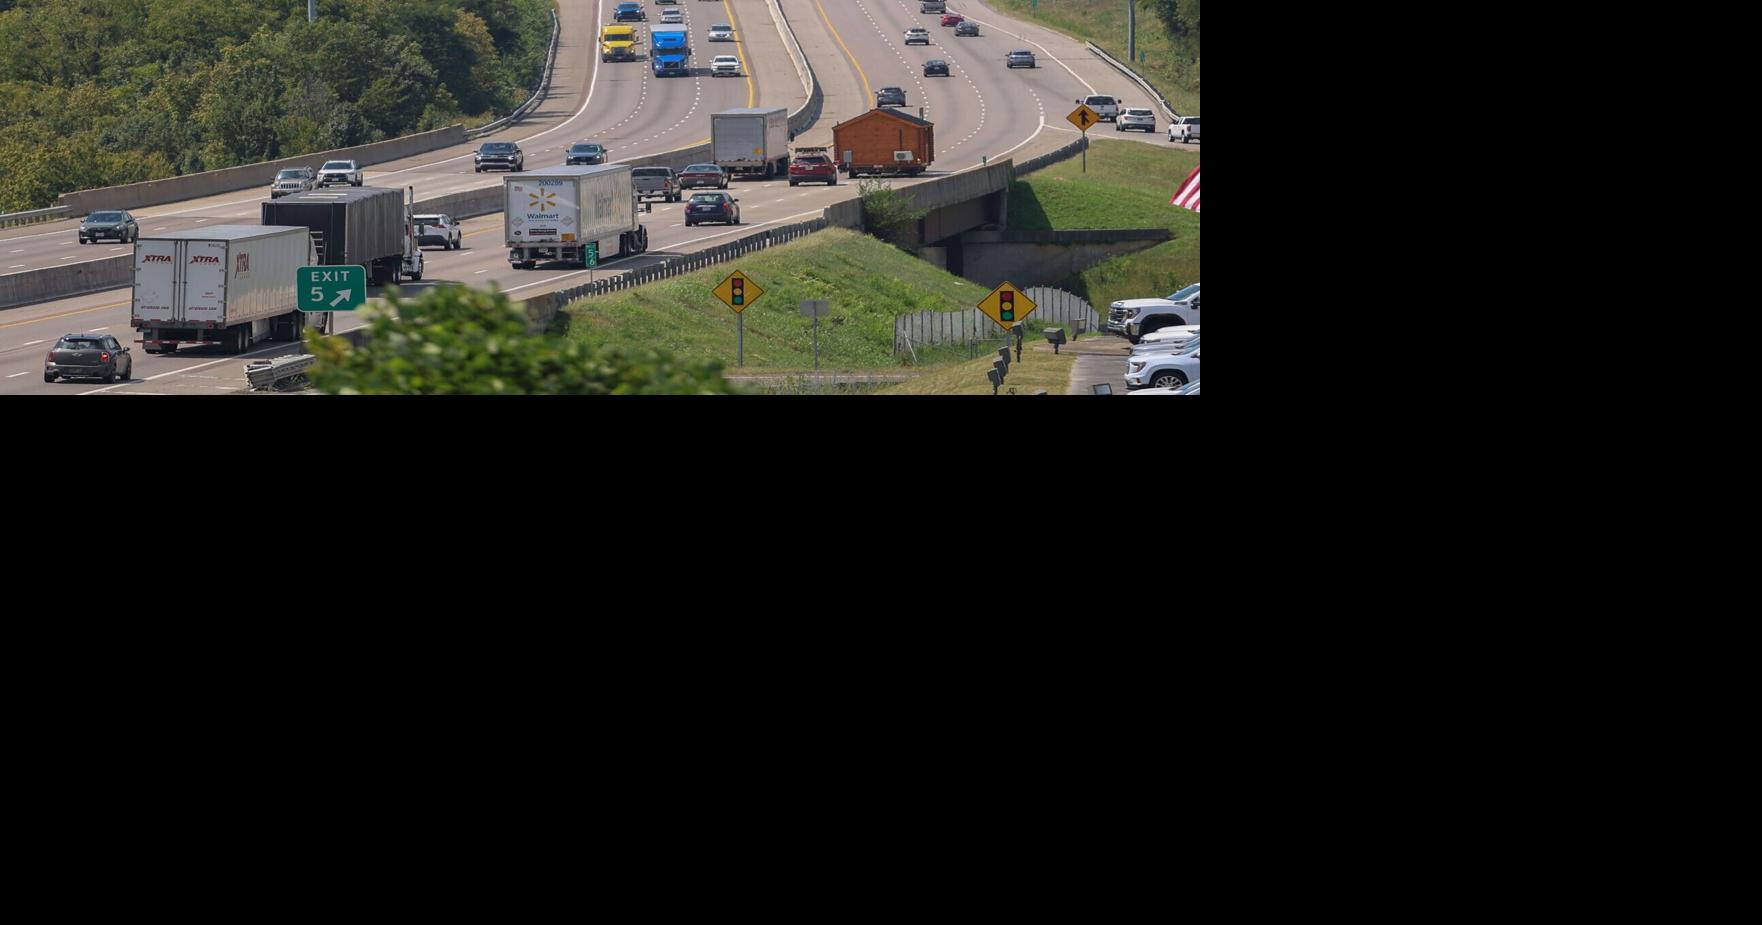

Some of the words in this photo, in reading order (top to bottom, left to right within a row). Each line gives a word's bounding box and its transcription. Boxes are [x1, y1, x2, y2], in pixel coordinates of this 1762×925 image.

[143, 255, 171, 263] XTRA
[188, 255, 219, 264] XTRA
[235, 251, 250, 278] XTRA
[311, 271, 350, 282] EXIT
[311, 286, 324, 302] 5
